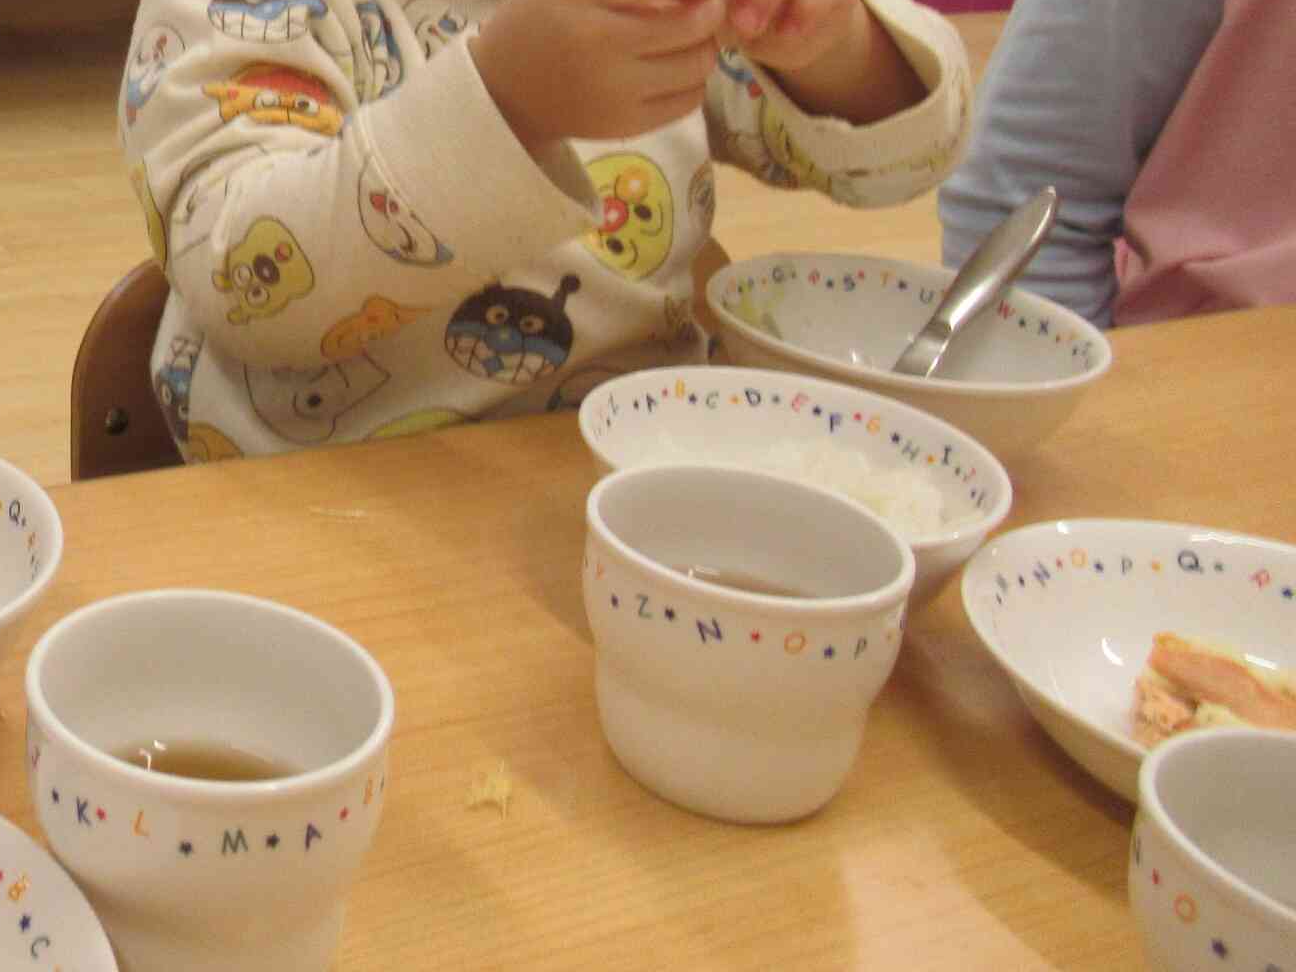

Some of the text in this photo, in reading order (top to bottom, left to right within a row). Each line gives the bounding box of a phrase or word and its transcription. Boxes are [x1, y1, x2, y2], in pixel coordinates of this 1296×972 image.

[8, 499, 22, 526] Q
[1177, 549, 1205, 574] Q
[635, 593, 653, 618] Z
[695, 617, 723, 644] N
[783, 631, 807, 654] O
[76, 795, 91, 826] K
[133, 811, 149, 837] L
[221, 829, 249, 856] M
[31, 936, 52, 959] C
